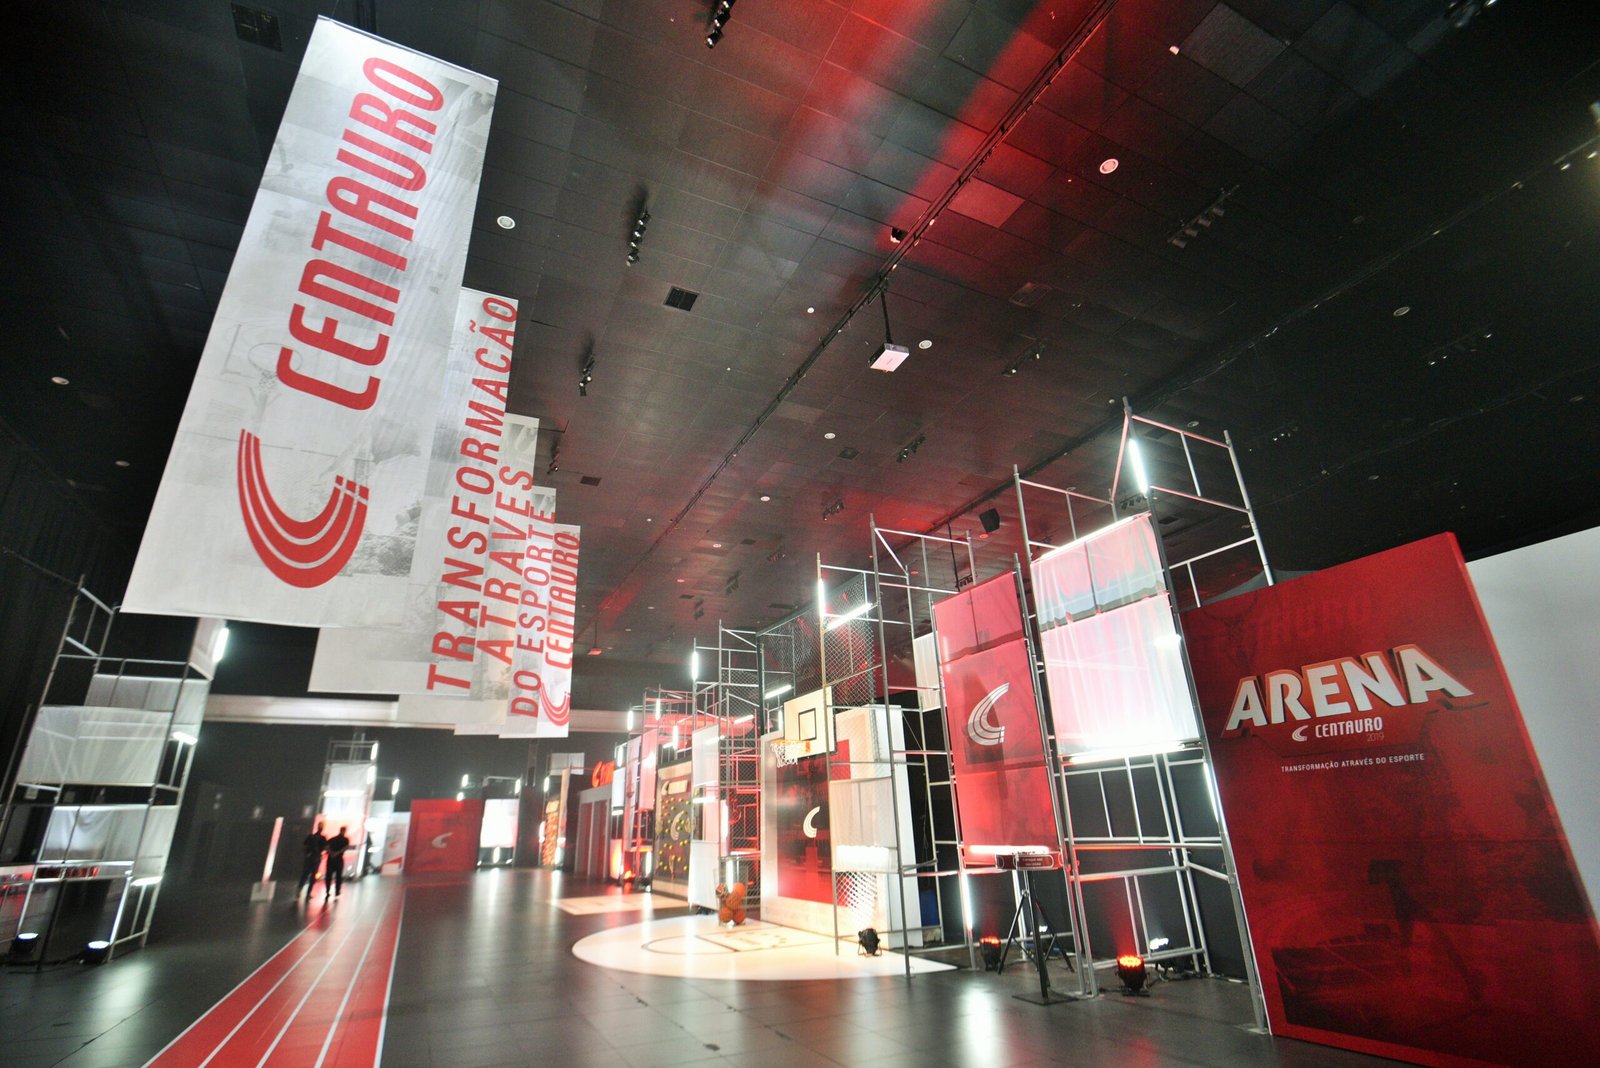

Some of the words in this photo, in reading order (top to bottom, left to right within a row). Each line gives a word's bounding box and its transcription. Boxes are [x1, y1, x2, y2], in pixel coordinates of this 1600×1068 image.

[276, 56, 445, 411] CENTAURO
[516, 506, 556, 654] ESPORTE
[545, 532, 580, 669] CENTAURO
[511, 670, 542, 718] DO
[1224, 646, 1475, 733] ARENA
[1315, 716, 1384, 738] CENTAURO
[1281, 761, 1339, 773] TRANSFORMAÇÃO
[1341, 757, 1374, 768] ATRAVÉS
[1376, 756, 1387, 765] DO
[1389, 753, 1425, 763] ESPORTE
